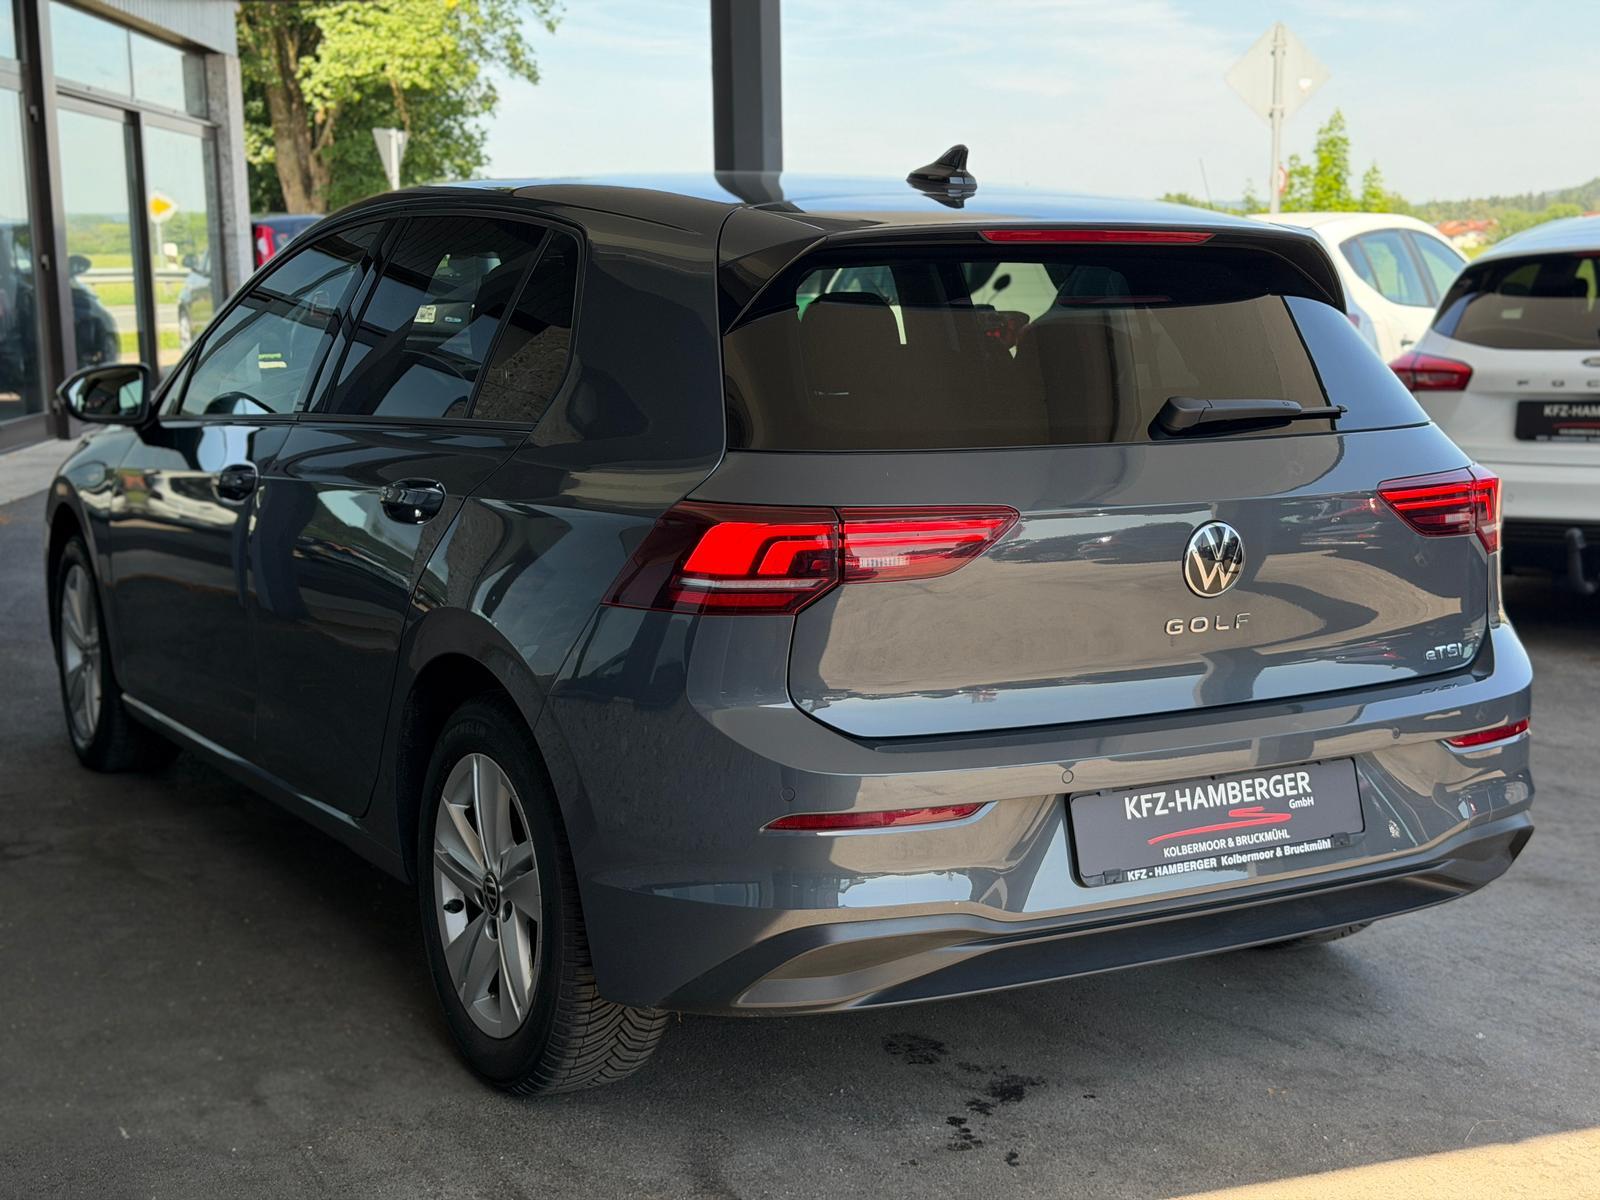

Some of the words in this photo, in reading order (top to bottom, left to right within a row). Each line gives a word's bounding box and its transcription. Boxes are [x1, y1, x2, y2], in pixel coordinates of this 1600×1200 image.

[1165, 612, 1251, 636] GOLF
[1124, 771, 1312, 820] KFZ-HAMBERGER
[1288, 796, 1315, 810] GmbH
[1163, 838, 1227, 858] KOLBERMOOR
[1227, 837, 1235, 848] &
[1236, 828, 1290, 846] BRUCKMÜHL
[1127, 870, 1148, 882] KFZ
[1154, 857, 1217, 877] HAMBERGER
[1221, 849, 1275, 866] Kolbermoor
[1275, 846, 1283, 858] &
[1284, 838, 1332, 856] Bruckmühl
